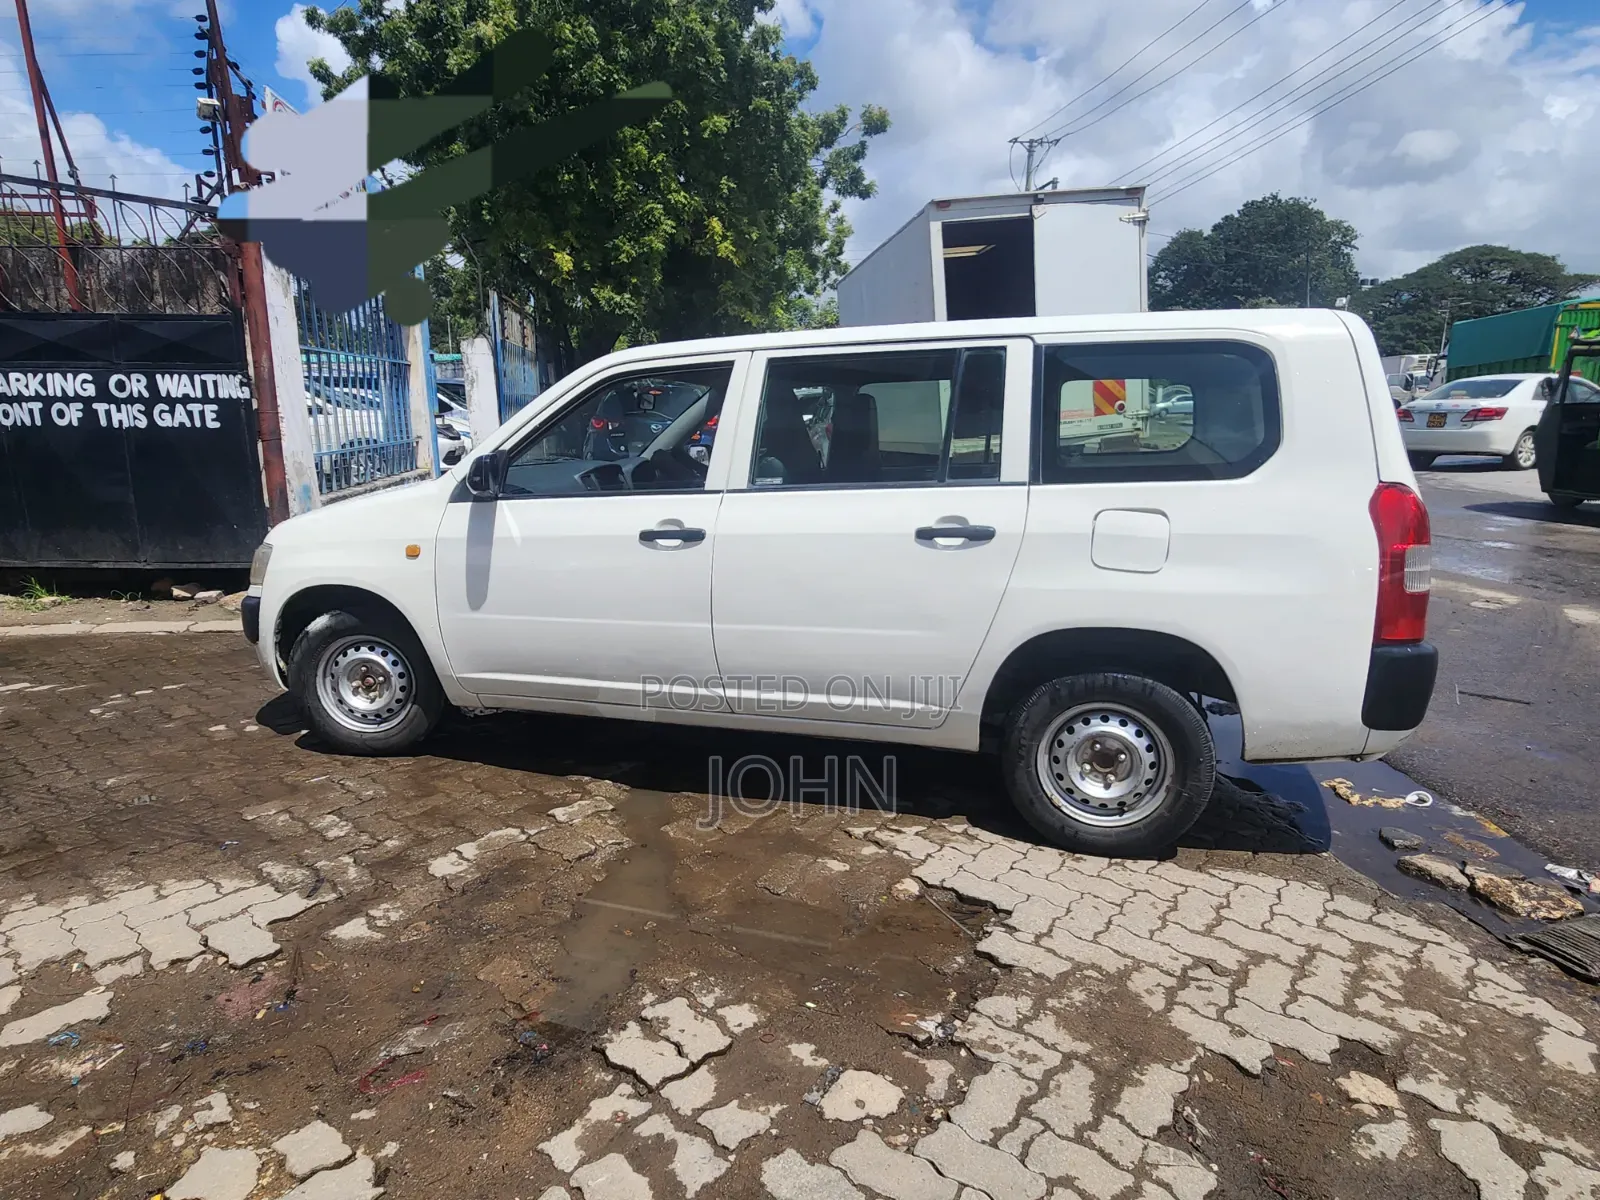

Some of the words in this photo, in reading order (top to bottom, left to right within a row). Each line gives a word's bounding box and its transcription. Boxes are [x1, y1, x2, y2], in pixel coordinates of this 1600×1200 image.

[108, 373, 149, 399] OR
[155, 373, 251, 399] WAITING
[51, 402, 83, 427] OF
[92, 403, 148, 428] THIS
[153, 403, 221, 428] GATE
